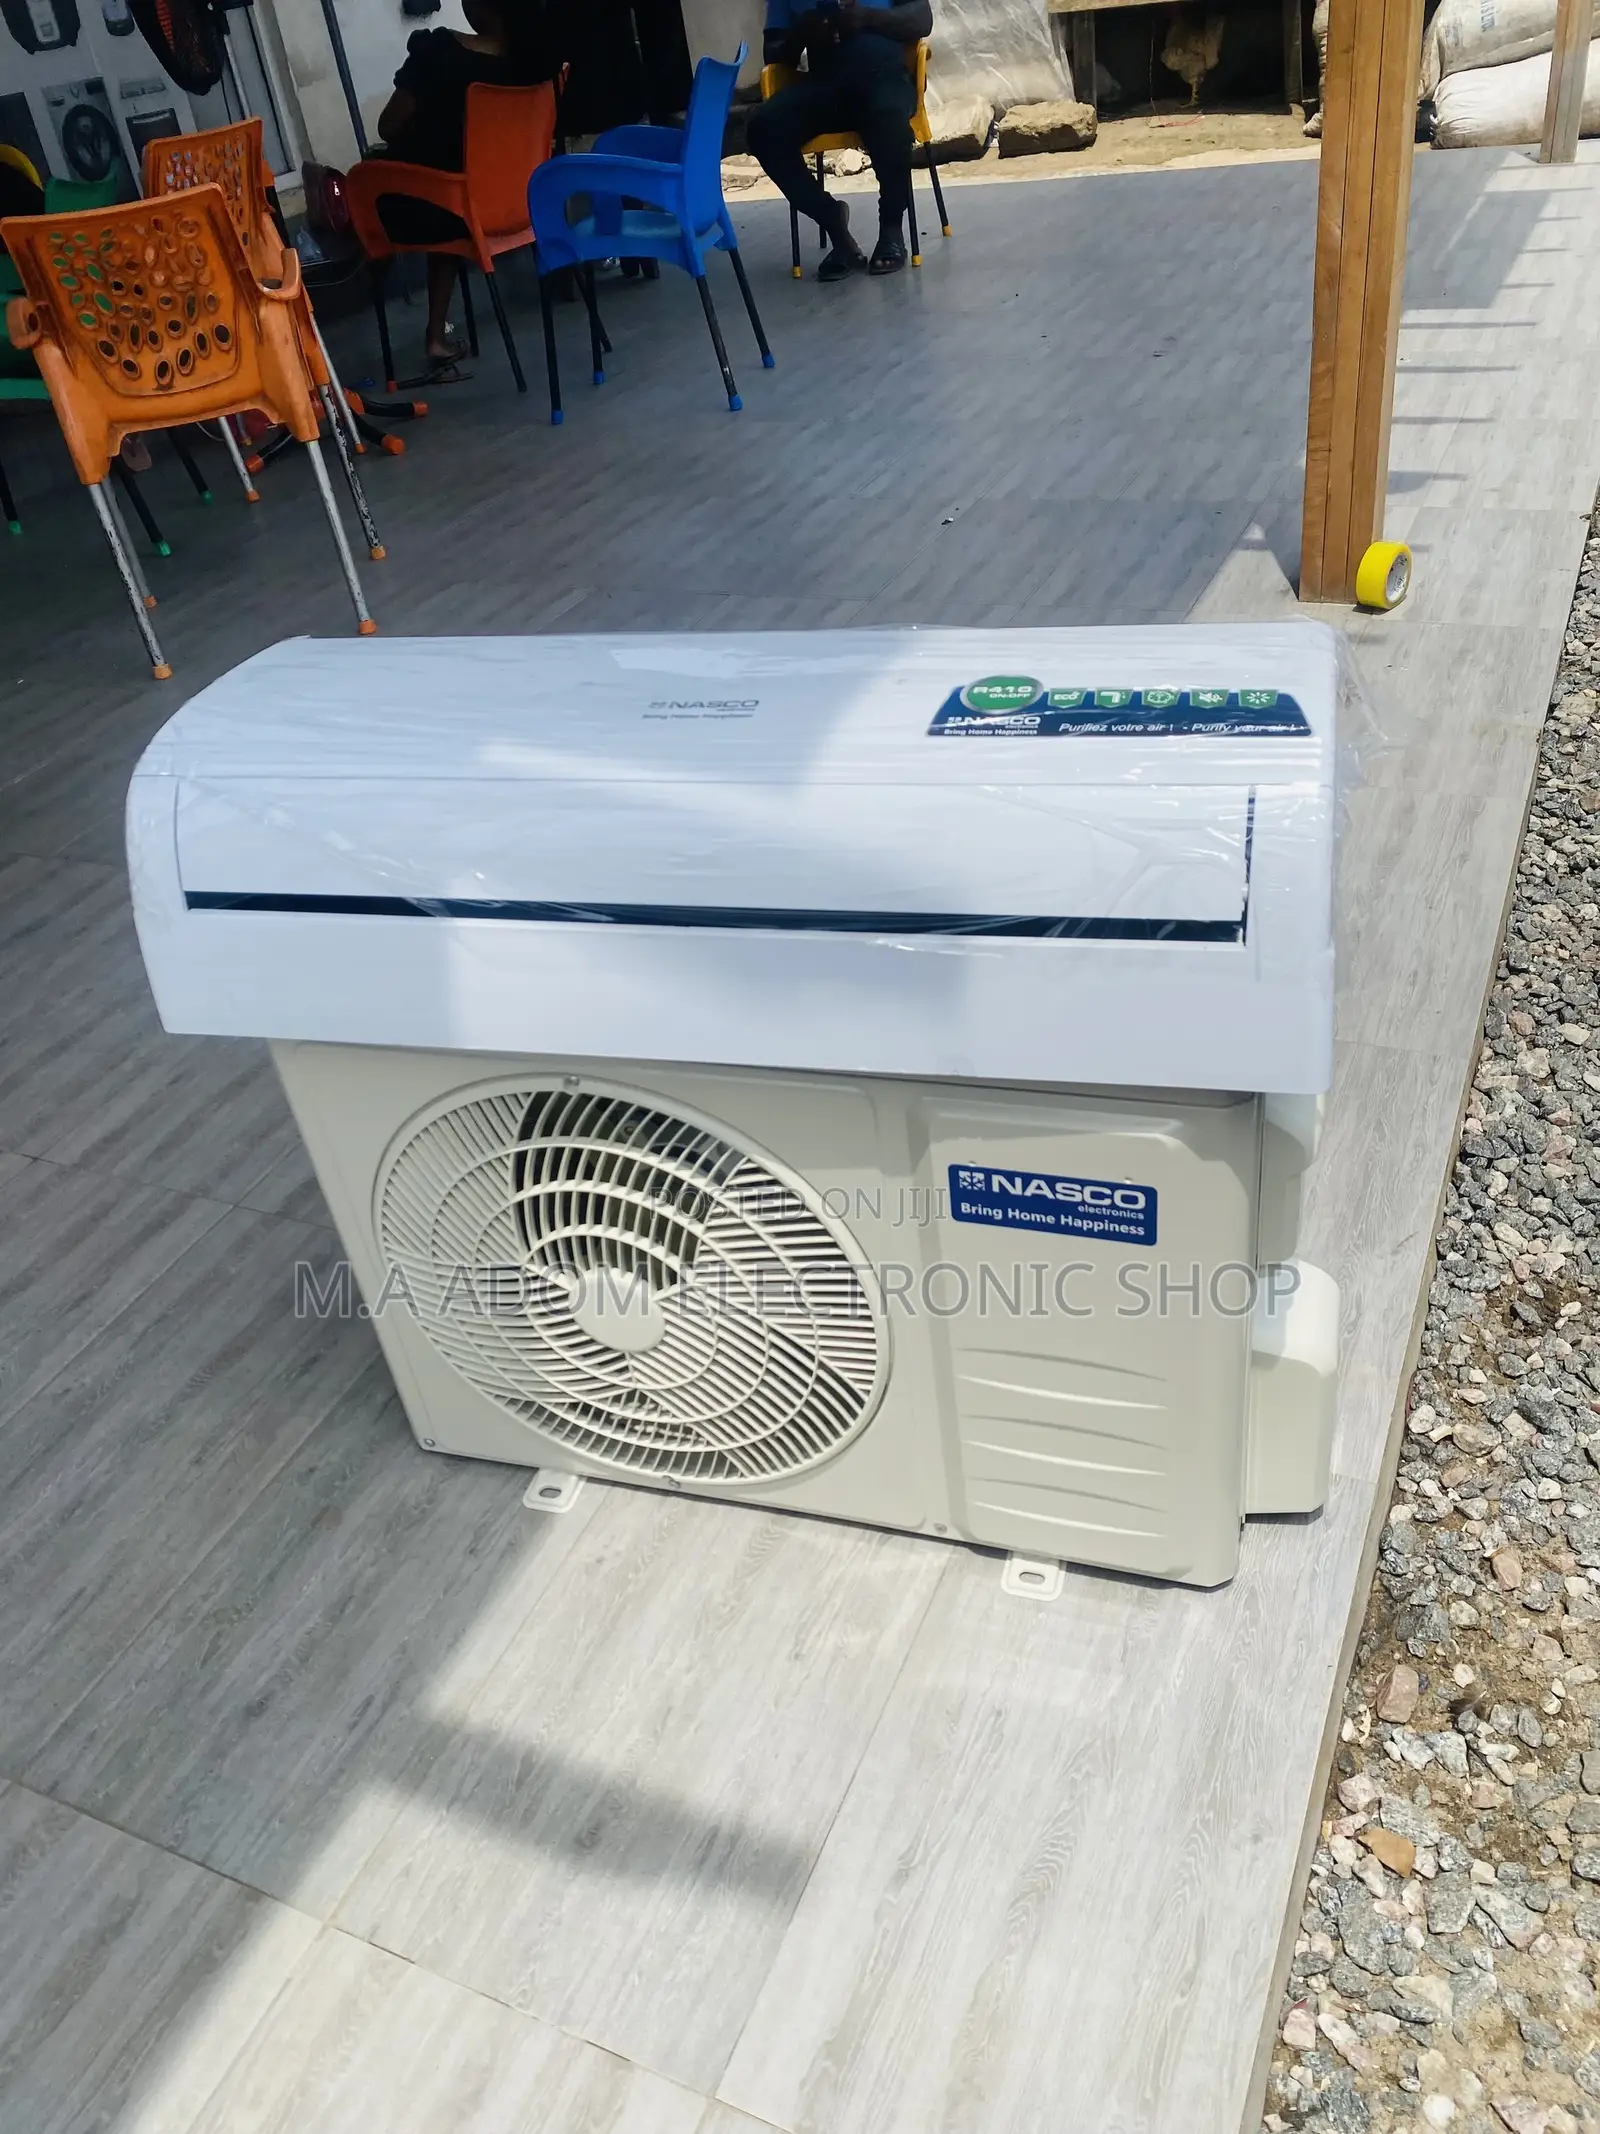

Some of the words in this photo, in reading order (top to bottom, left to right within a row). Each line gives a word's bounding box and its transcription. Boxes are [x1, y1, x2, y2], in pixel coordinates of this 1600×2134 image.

[668, 699, 760, 709] NASCO
[944, 728, 967, 736] Bring
[995, 728, 1038, 736] Happiness
[1059, 723, 1108, 732] Purifiez
[1111, 724, 1144, 732] votre
[1147, 723, 1166, 732] air
[1191, 722, 1232, 733] Purify
[991, 1173, 1146, 1210] NASCO
[960, 1202, 1004, 1220] Bring
[1008, 1208, 1056, 1225] Home
[1060, 1214, 1146, 1236] Happiness
[1078, 1204, 1145, 1221] electronics
